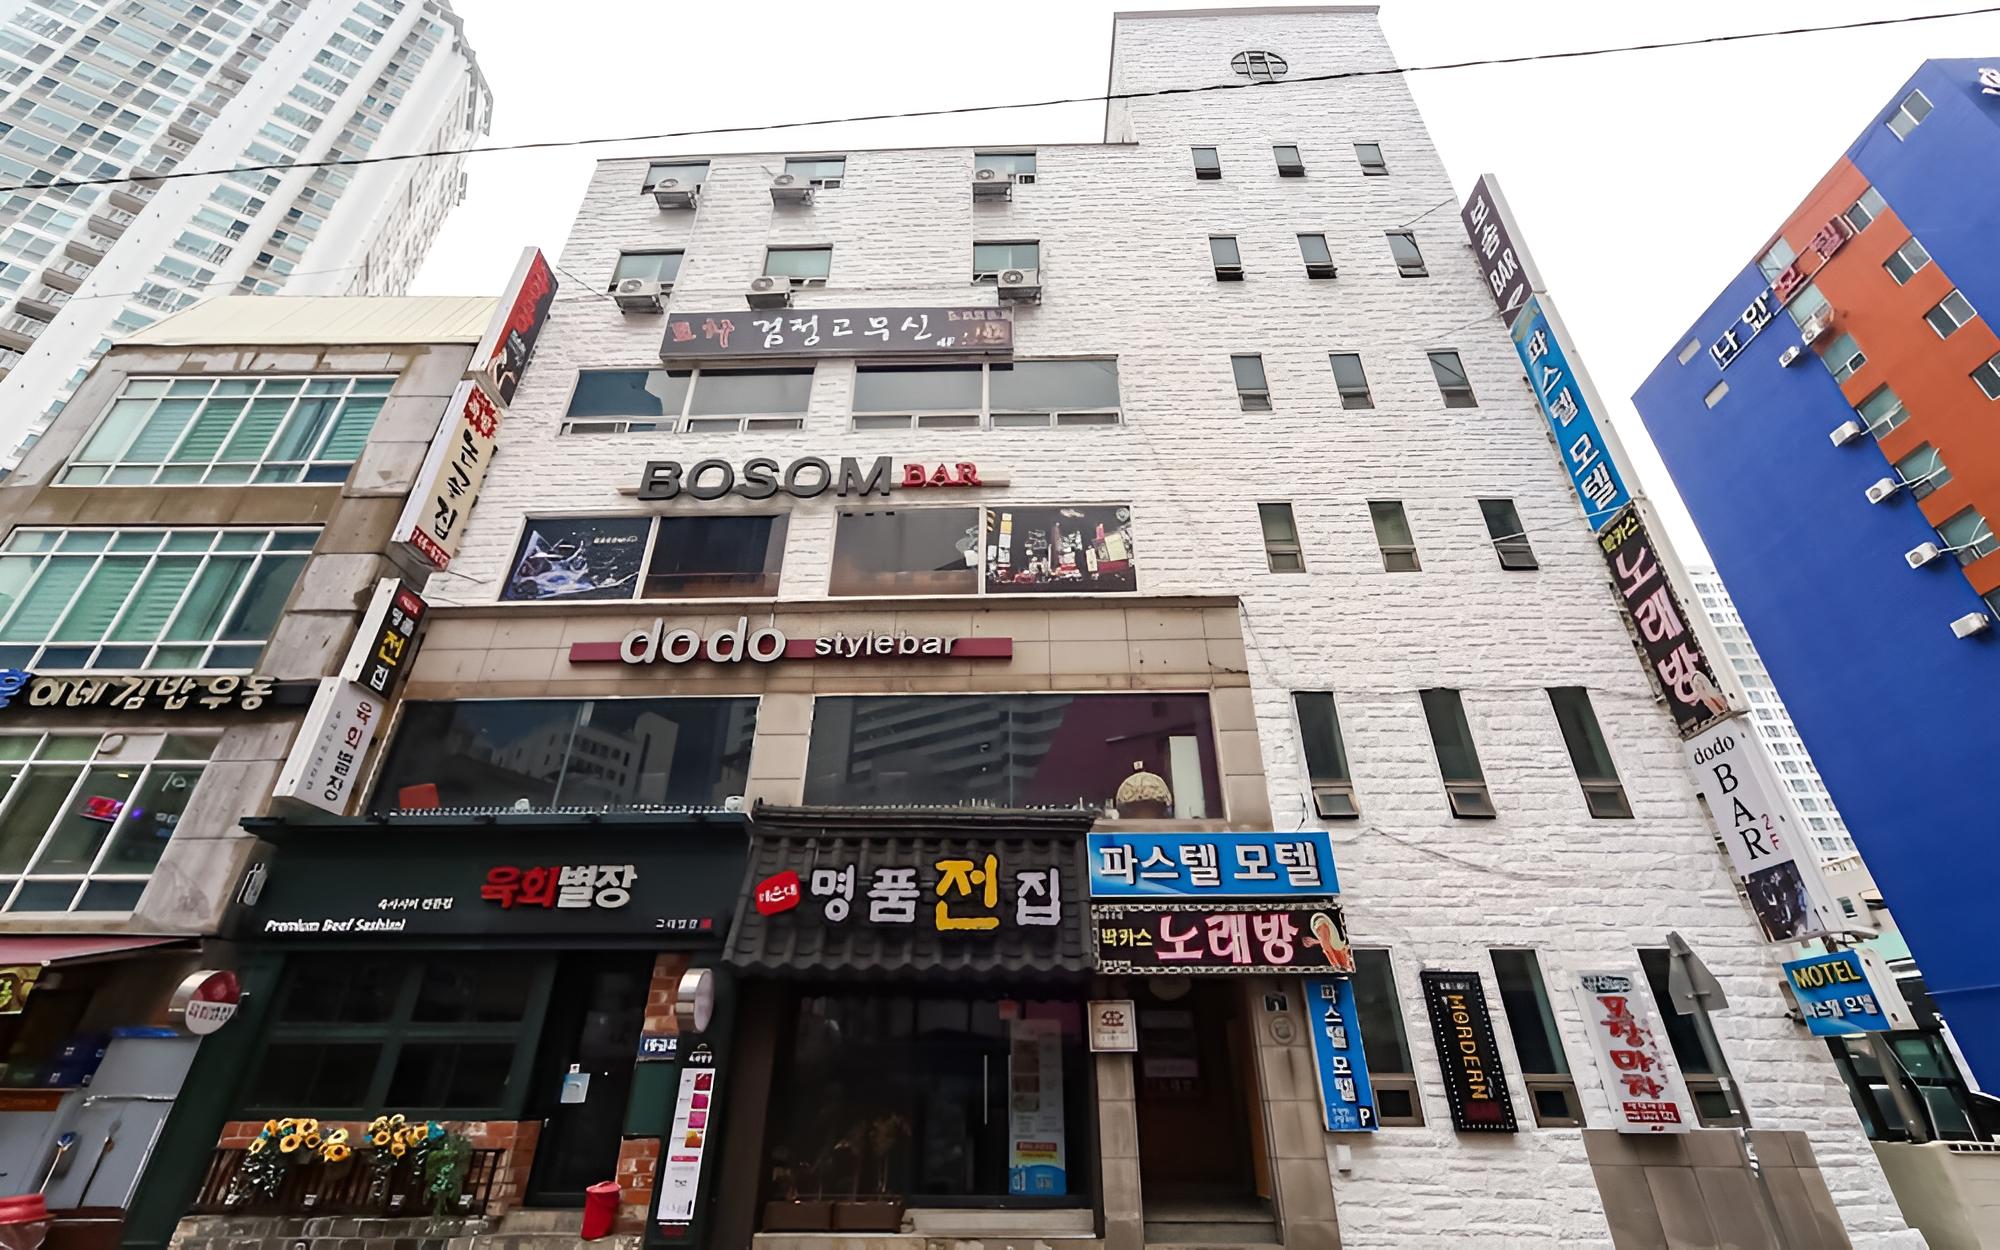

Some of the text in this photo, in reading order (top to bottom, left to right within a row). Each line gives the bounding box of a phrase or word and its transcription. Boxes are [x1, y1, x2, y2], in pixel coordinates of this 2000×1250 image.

[1489, 247, 1518, 297] BAR
[752, 314, 933, 348] 검정고무신
[637, 456, 982, 500] BOSOM BAR
[619, 616, 787, 663] dodo
[1615, 546, 1701, 707] 노래방
[1694, 736, 1735, 765] dodo
[1712, 763, 1771, 860] BAR
[1099, 842, 1322, 887] 파스텔 모텔
[1156, 913, 1299, 964] 노래방
[1792, 960, 1862, 989] MOTEL
